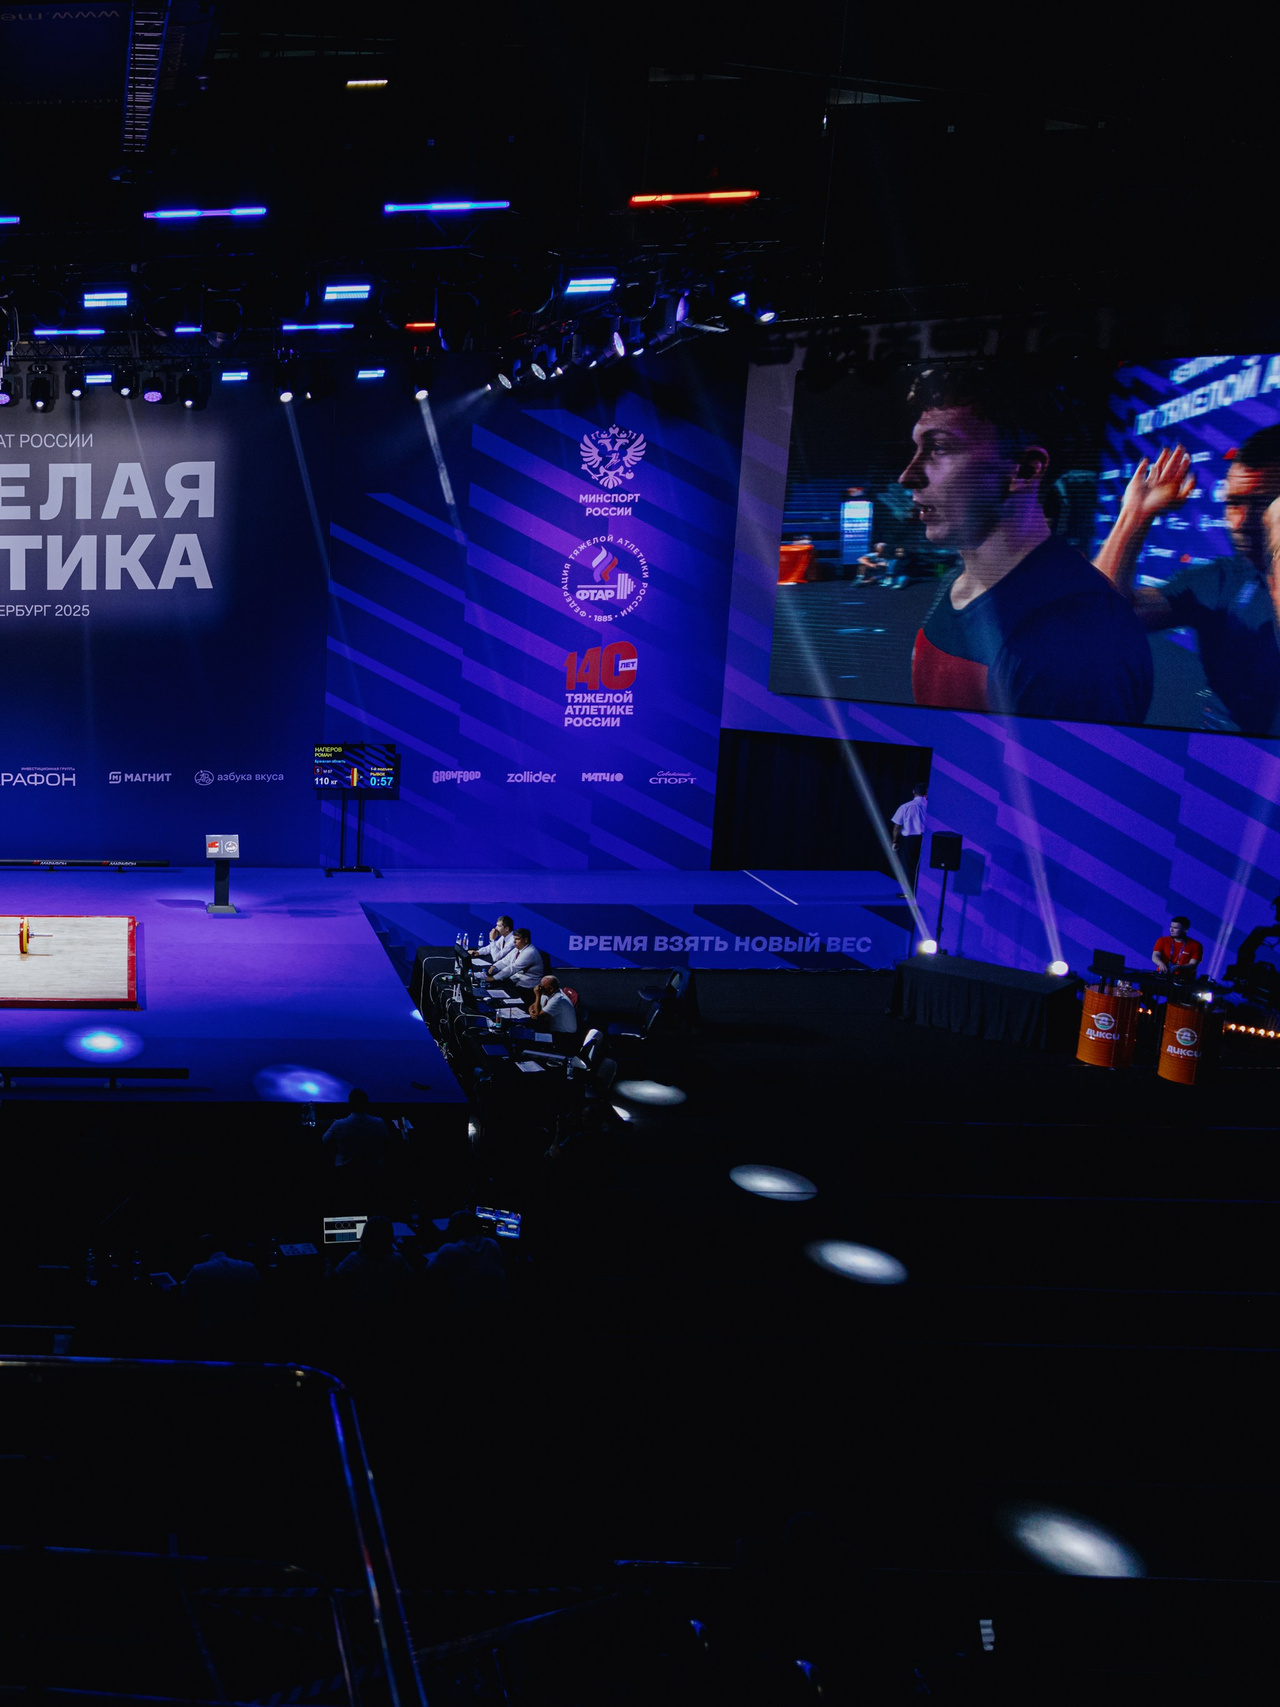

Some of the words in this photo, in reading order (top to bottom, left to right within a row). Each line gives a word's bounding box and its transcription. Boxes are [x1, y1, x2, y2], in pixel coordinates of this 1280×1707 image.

[20, 433, 93, 449] РОССИИ
[579, 494, 640, 503] МИНСПОРТ
[586, 507, 632, 516] РОССИИ
[568, 534, 614, 560] ТЯЖЕЛОЙ
[617, 538, 649, 578] АТЛЕТИКИ
[561, 563, 587, 617] ФЕДЕРАЦИЯ
[576, 590, 615, 600] ФТАР
[620, 582, 648, 617] РОССИИ
[55, 604, 90, 617] 2025
[594, 614, 613, 622] 1885
[565, 691, 633, 703] ТЯЖЕЛОЙ
[565, 705, 634, 715] АТЛЕТИКЕ
[564, 717, 620, 727] РОССИИ
[125, 772, 172, 782] МАГНИТ
[217, 772, 252, 783] азбука
[255, 774, 284, 783] вкуса
[315, 777, 329, 785] 110
[370, 777, 393, 786] 0:57
[433, 770, 481, 784] GROWFOOD
[569, 935, 648, 951] ВРЕМЯ
[654, 936, 728, 951] ВЗЯТЬ
[734, 932, 820, 952] НОВЫЙ
[826, 937, 872, 953] ВЕС
